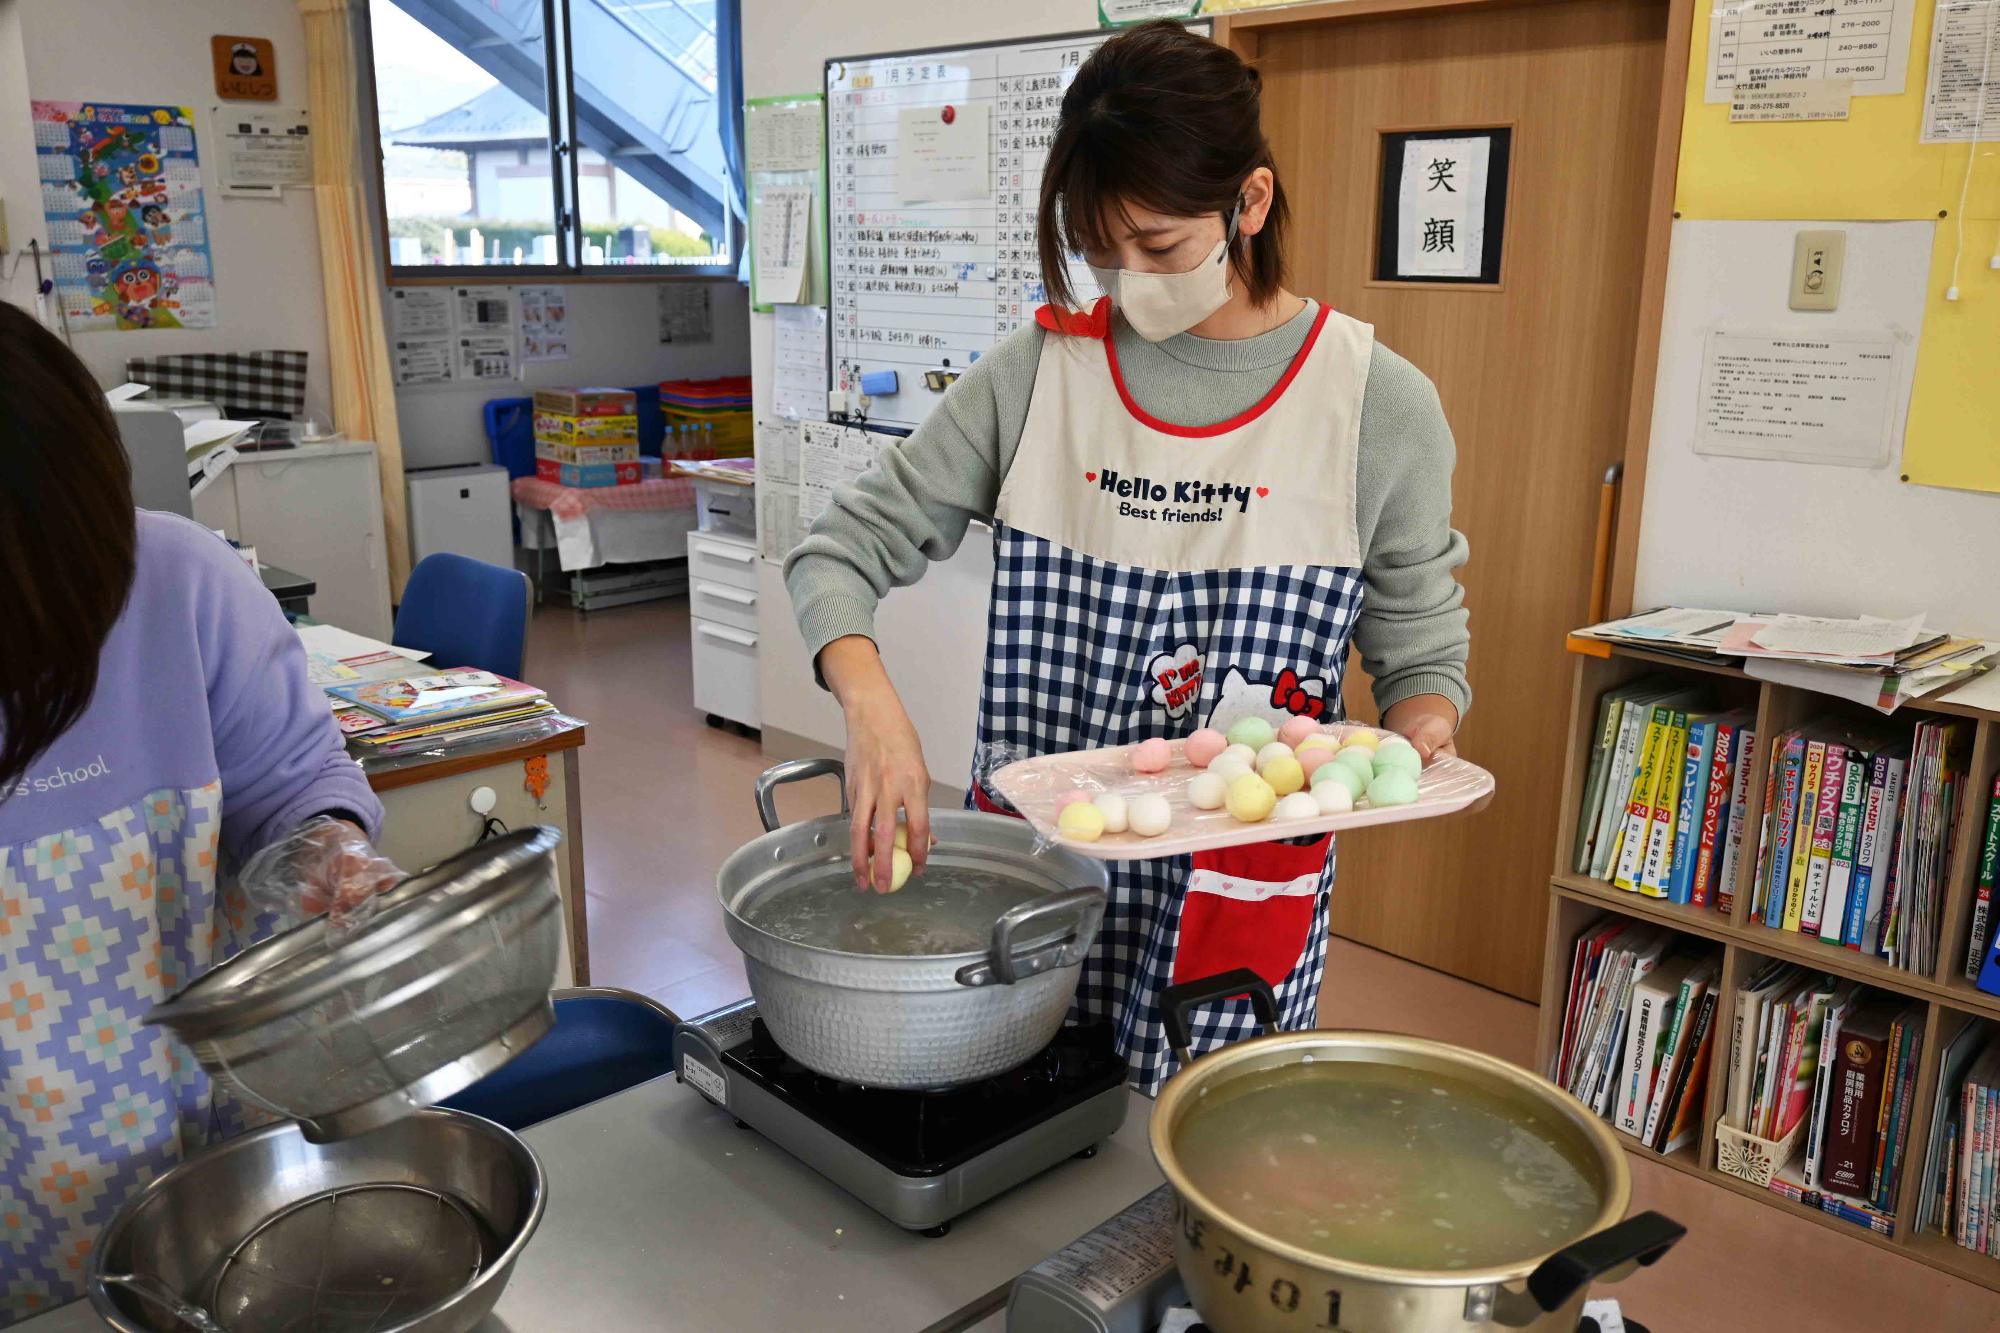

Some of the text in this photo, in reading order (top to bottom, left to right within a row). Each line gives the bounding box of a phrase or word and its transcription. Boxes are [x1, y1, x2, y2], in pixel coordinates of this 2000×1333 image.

[1421, 157, 1458, 254] 笑顔
[1100, 468, 1252, 514] Hello Kitty
[1118, 502, 1223, 523] Best friends!
[1157, 658, 1200, 691] I'm
[1640, 726, 1661, 796] スマートスクール
[1660, 728, 1681, 801] スマートスクール
[1807, 763, 1819, 790] サクラ
[1873, 757, 1886, 786] 2024
[1702, 732, 1731, 846] 2024 ひかりのくに
[1819, 755, 1844, 816] ウチダス
[1776, 769, 1797, 848] チャイルドブック
[1831, 859, 1851, 869] 2023
[1854, 1071, 1866, 1100] 業務用
[1843, 1159, 1854, 1170] 21
